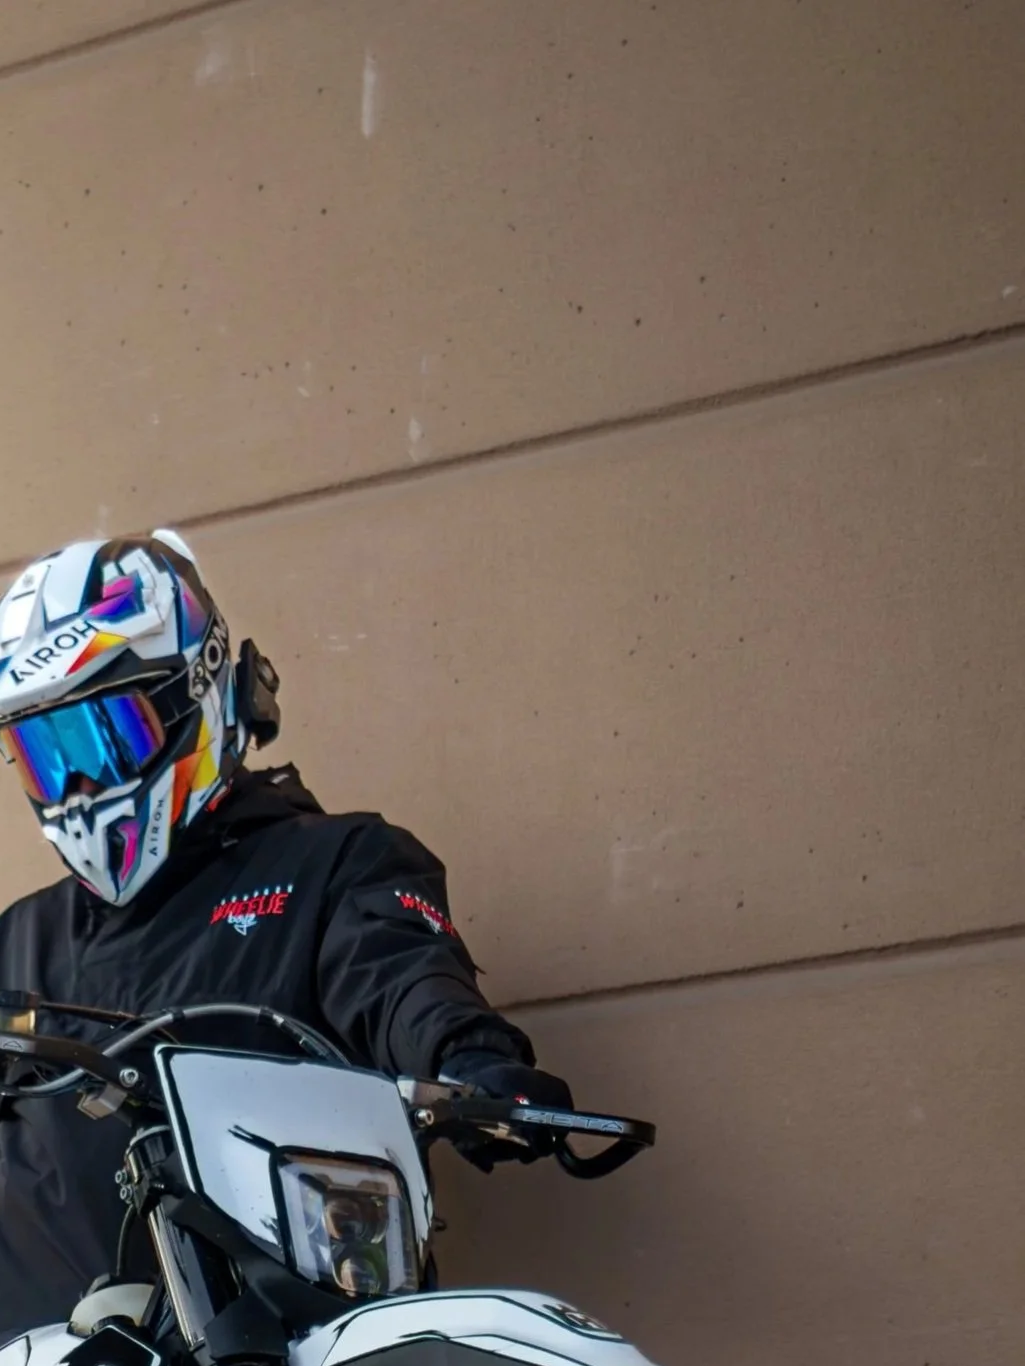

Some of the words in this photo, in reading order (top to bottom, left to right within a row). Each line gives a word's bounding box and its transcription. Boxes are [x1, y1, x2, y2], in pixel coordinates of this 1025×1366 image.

[9, 619, 100, 686] AIROH
[149, 799, 165, 857] AIROH
[522, 1108, 624, 1134] ZETA
